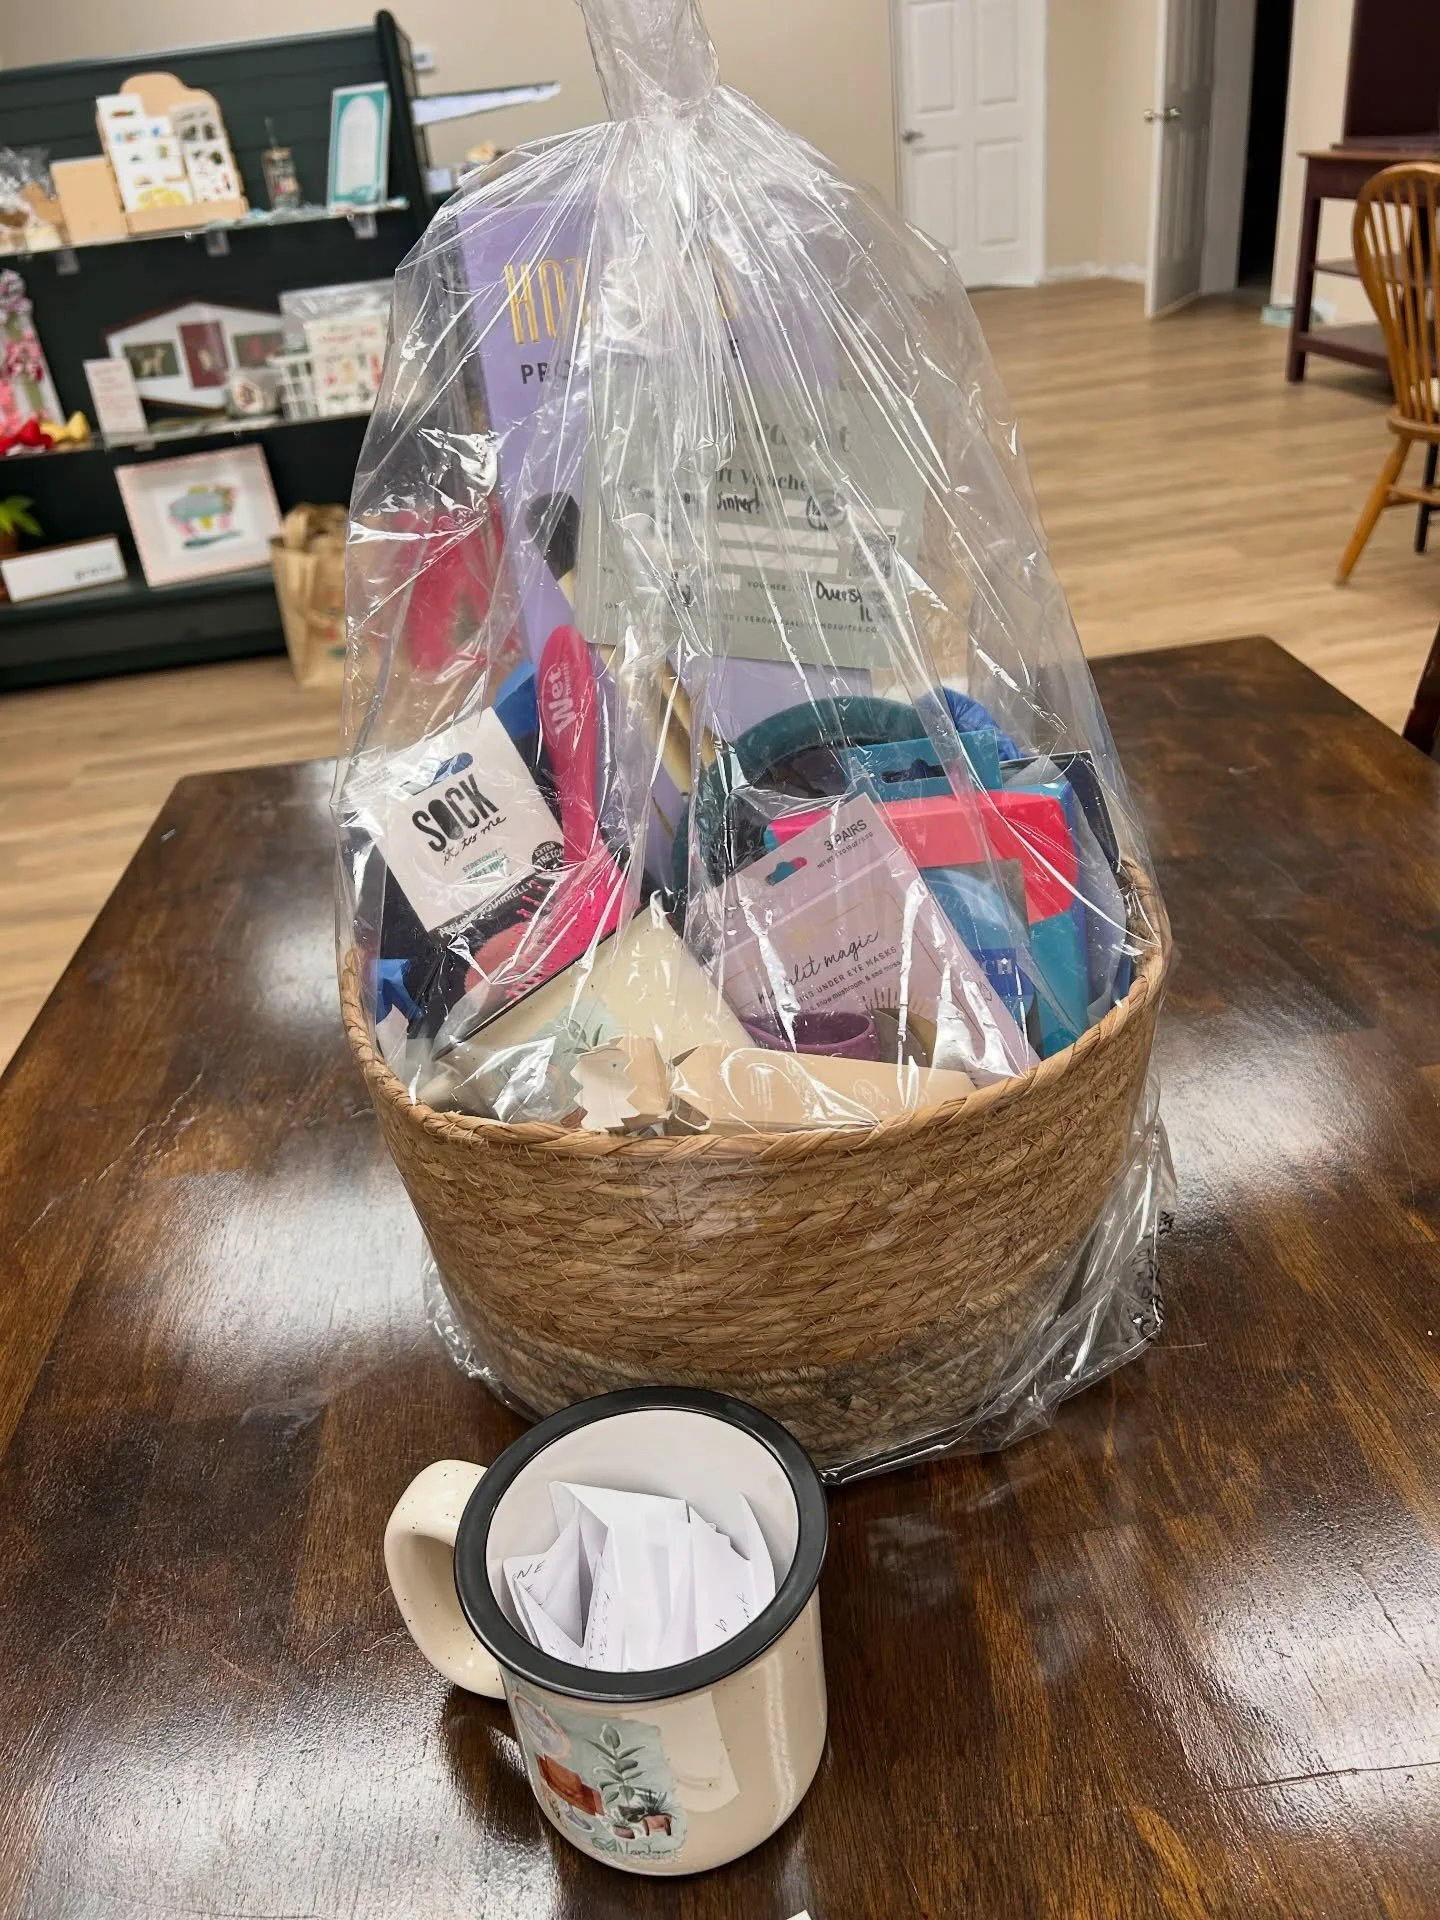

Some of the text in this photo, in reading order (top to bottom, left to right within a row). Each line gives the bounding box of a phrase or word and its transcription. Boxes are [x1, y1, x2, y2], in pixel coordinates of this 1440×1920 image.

[548, 667, 577, 736] Wet
[412, 774, 499, 852] SOCK
[823, 820, 867, 851] 3 PAIRS
[443, 816, 507, 866] it to me
[534, 841, 556, 857] EXTRA
[815, 946, 897, 993] UNDER EYE MASKS
[823, 931, 879, 968] magic
